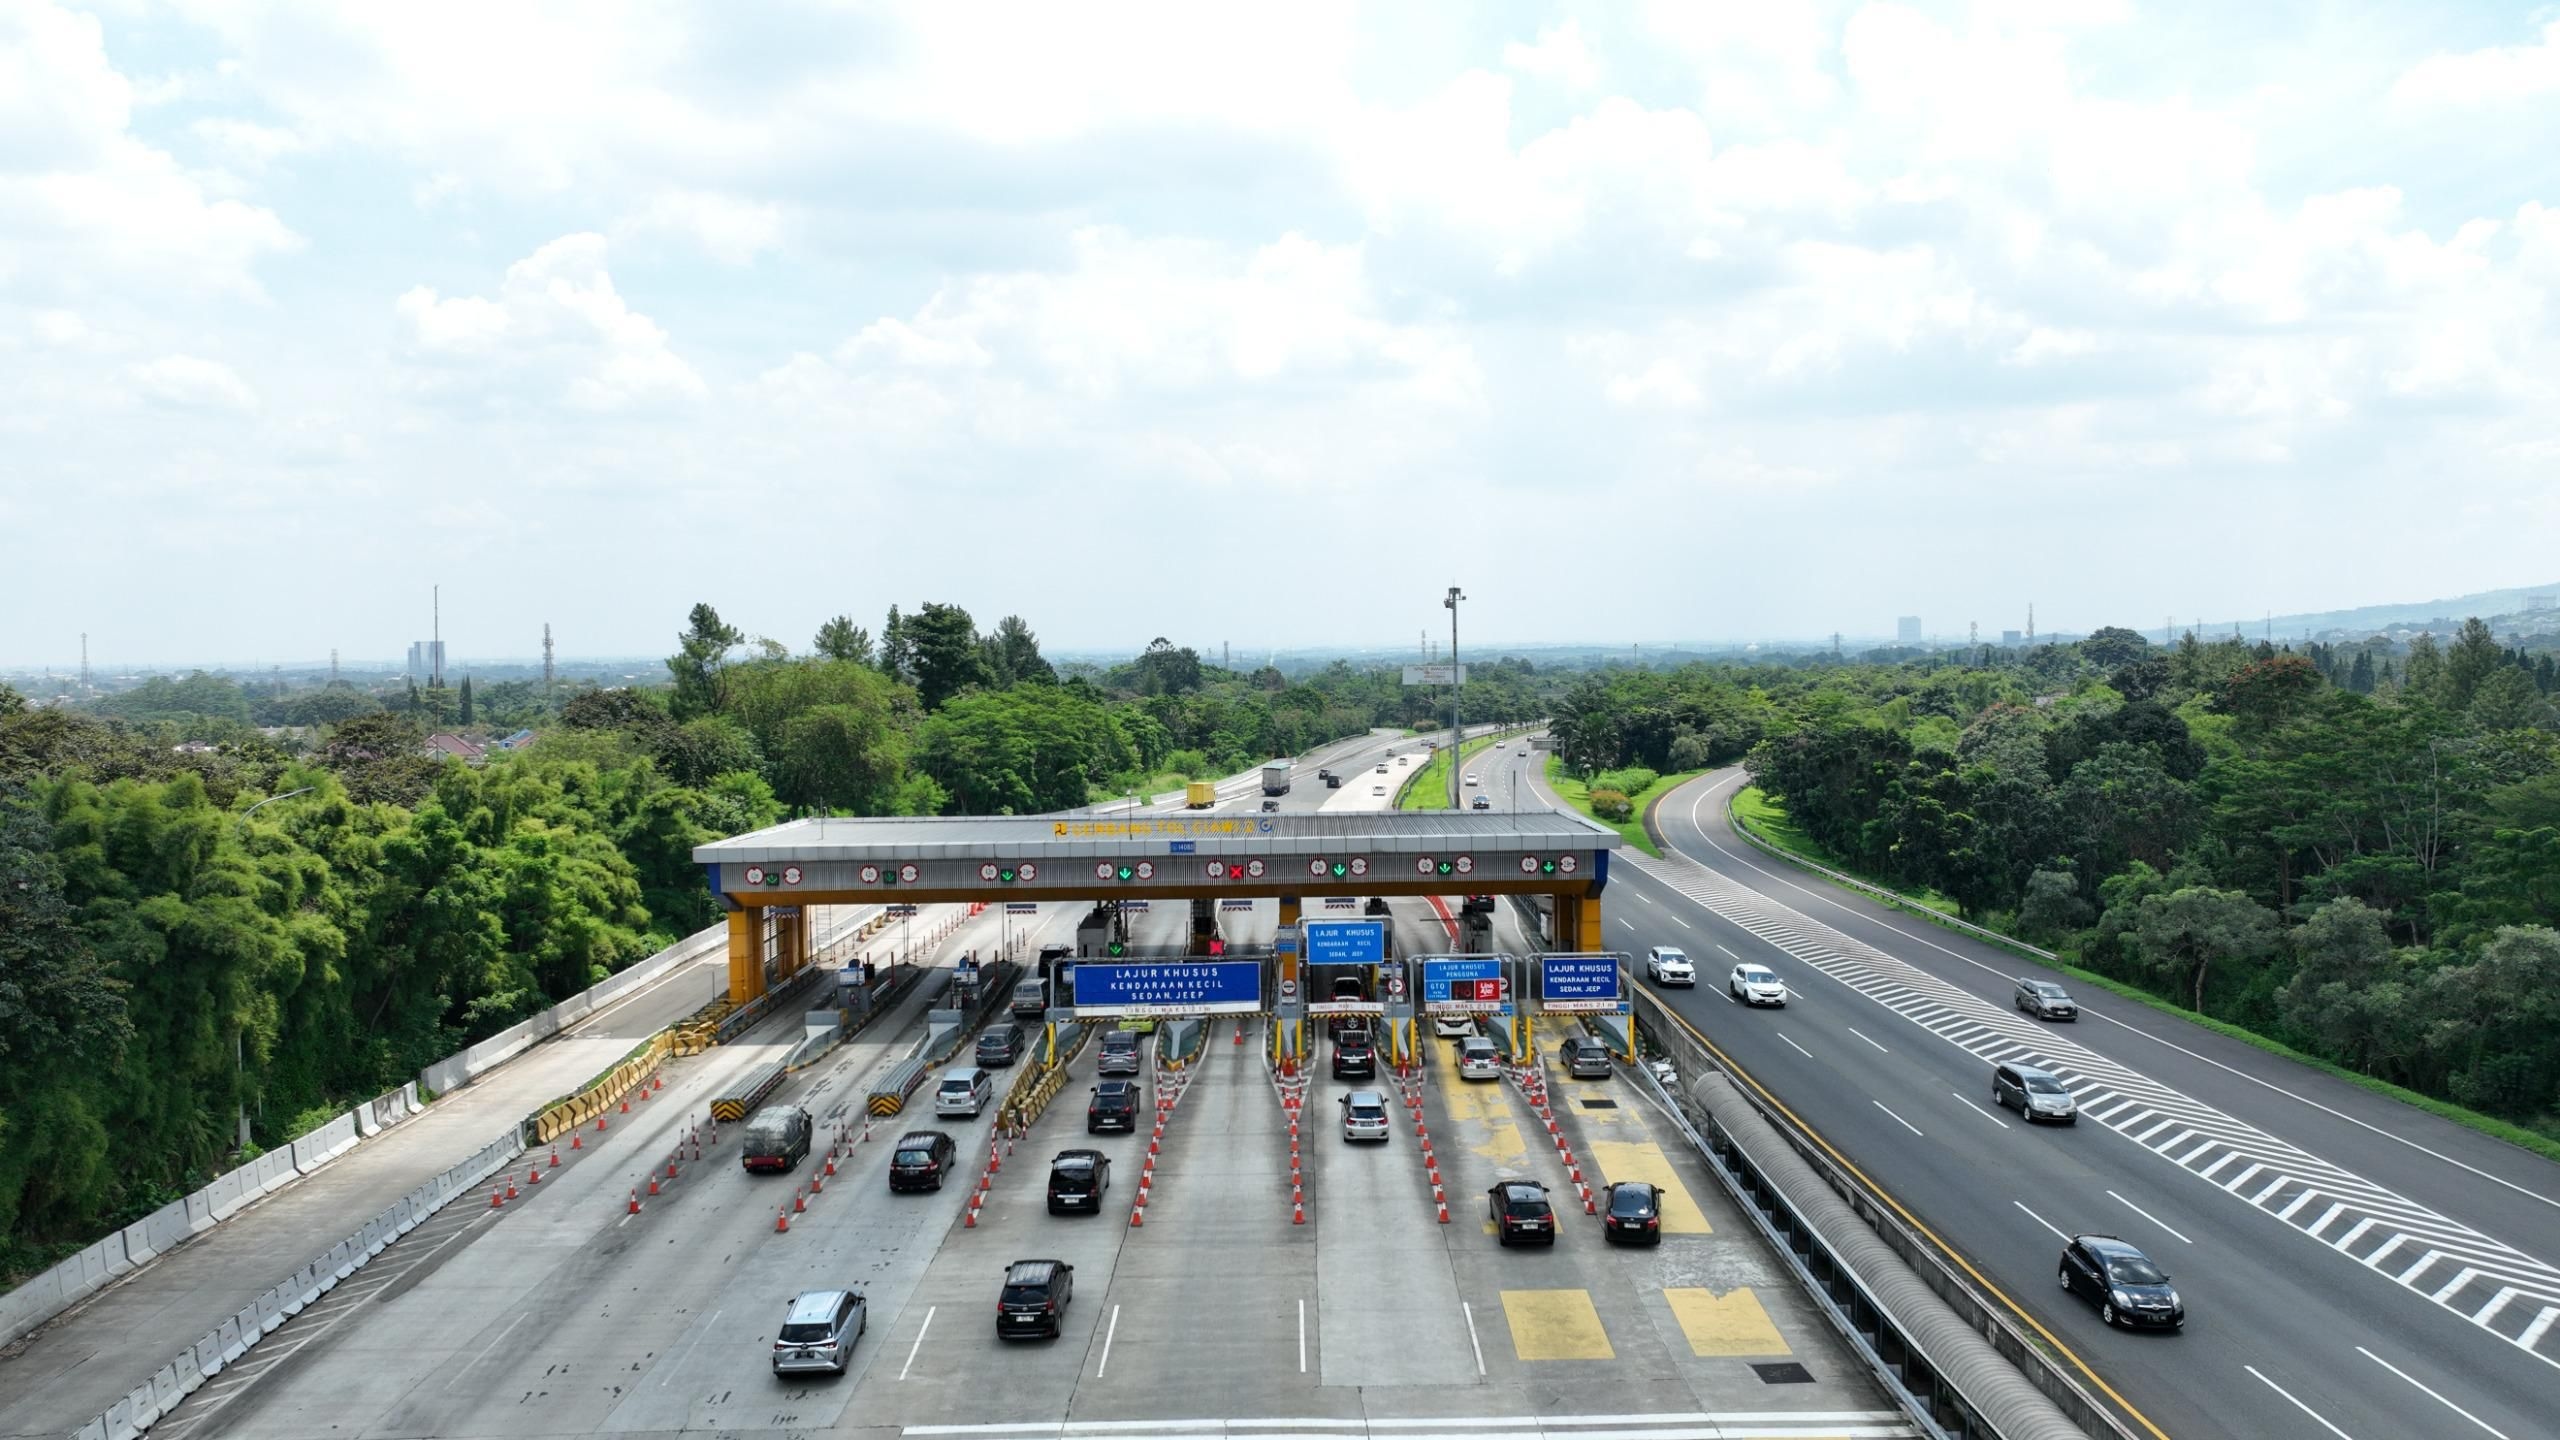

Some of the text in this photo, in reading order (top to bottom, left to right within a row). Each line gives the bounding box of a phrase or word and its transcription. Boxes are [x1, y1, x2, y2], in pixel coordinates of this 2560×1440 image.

[1116, 968, 1218, 979] LAJUR KHUSUS
[1549, 965, 1575, 973] LAJUR
[1110, 980, 1223, 990] KENDARAAN KECIL
[1176, 991, 1204, 999] JEEP
